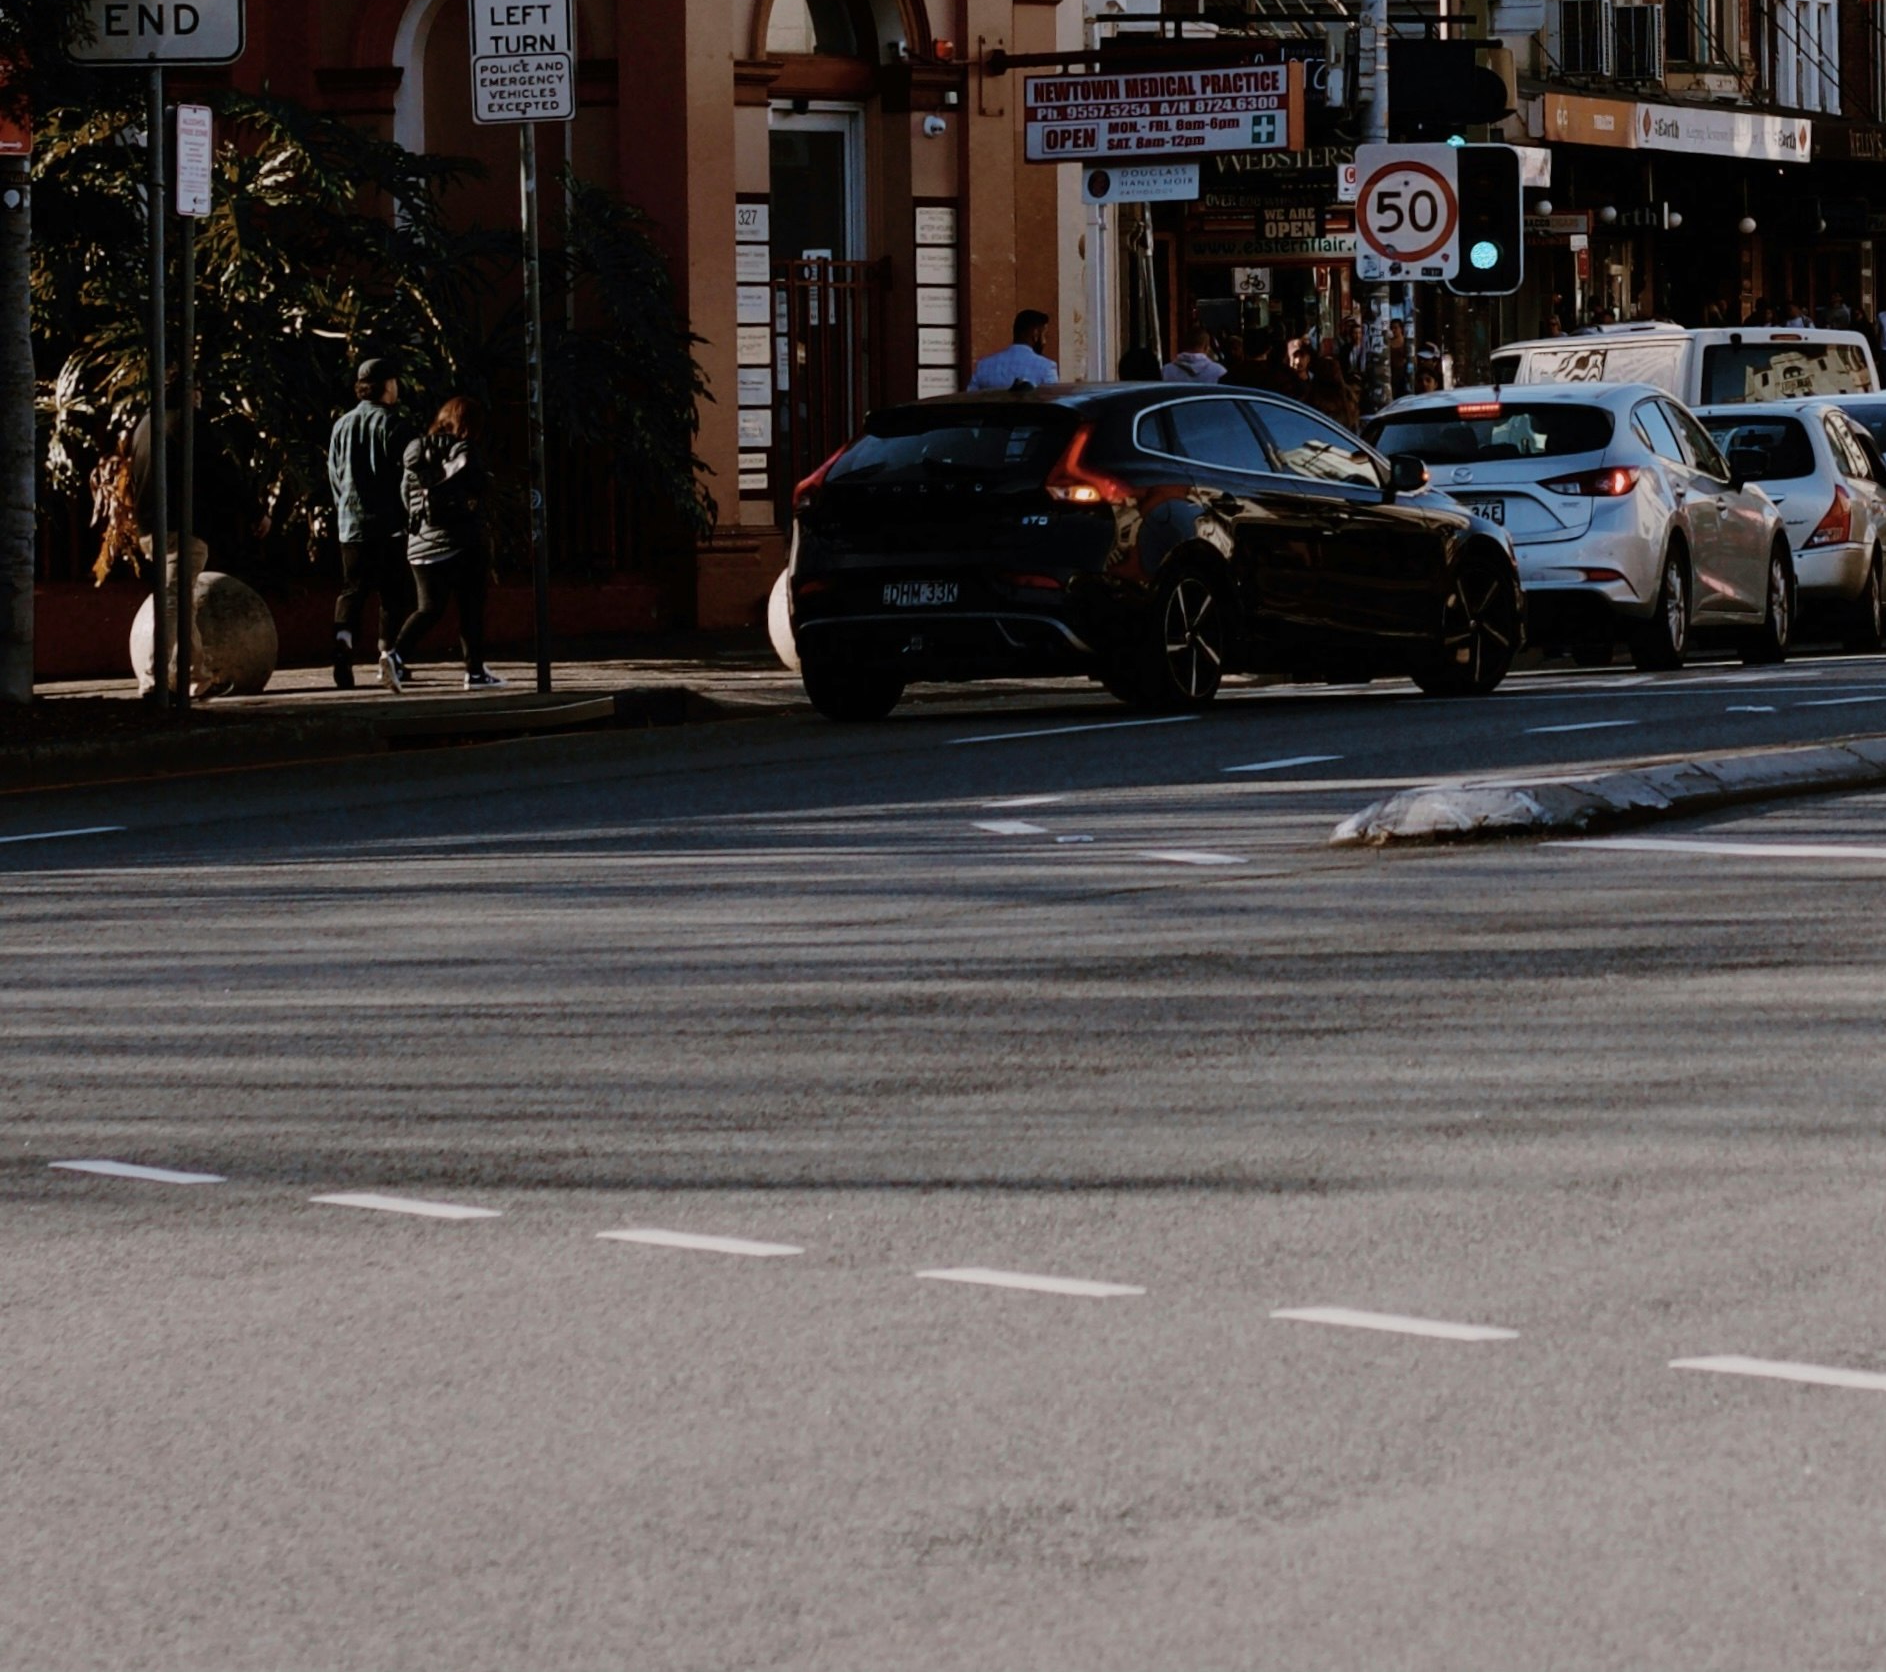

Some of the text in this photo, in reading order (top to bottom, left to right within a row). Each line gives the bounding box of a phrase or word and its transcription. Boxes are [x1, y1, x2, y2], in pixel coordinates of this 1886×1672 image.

[105, 4, 200, 36] END
[491, 5, 551, 26] LEFT
[490, 35, 556, 54] TURN
[480, 61, 564, 75] POLICE AND
[480, 74, 565, 88] EMERGENCY
[1034, 70, 1280, 104] NEWTOWN MEDICAL PRACTICE
[489, 88, 557, 100] VEHICLES
[488, 100, 559, 114] EXCEPTED
[1036, 95, 1279, 121] Ph. 9557.5254 A/H 8724.6300
[1176, 117, 1240, 132] 8am-6pm
[1046, 129, 1096, 151] OPEN
[1107, 134, 1205, 150] SAT. 8am-12pm
[1216, 145, 1355, 174] WEBSTERS
[1121, 167, 1188, 178] DOUGLASS
[1120, 177, 1193, 188] HANLY MOIR
[738, 212, 757, 225] 327
[1264, 207, 1315, 220] WE ARE
[1376, 190, 1438, 234] 50
[1265, 220, 1317, 239] OPEN
[866, 481, 985, 495] VOLVO
